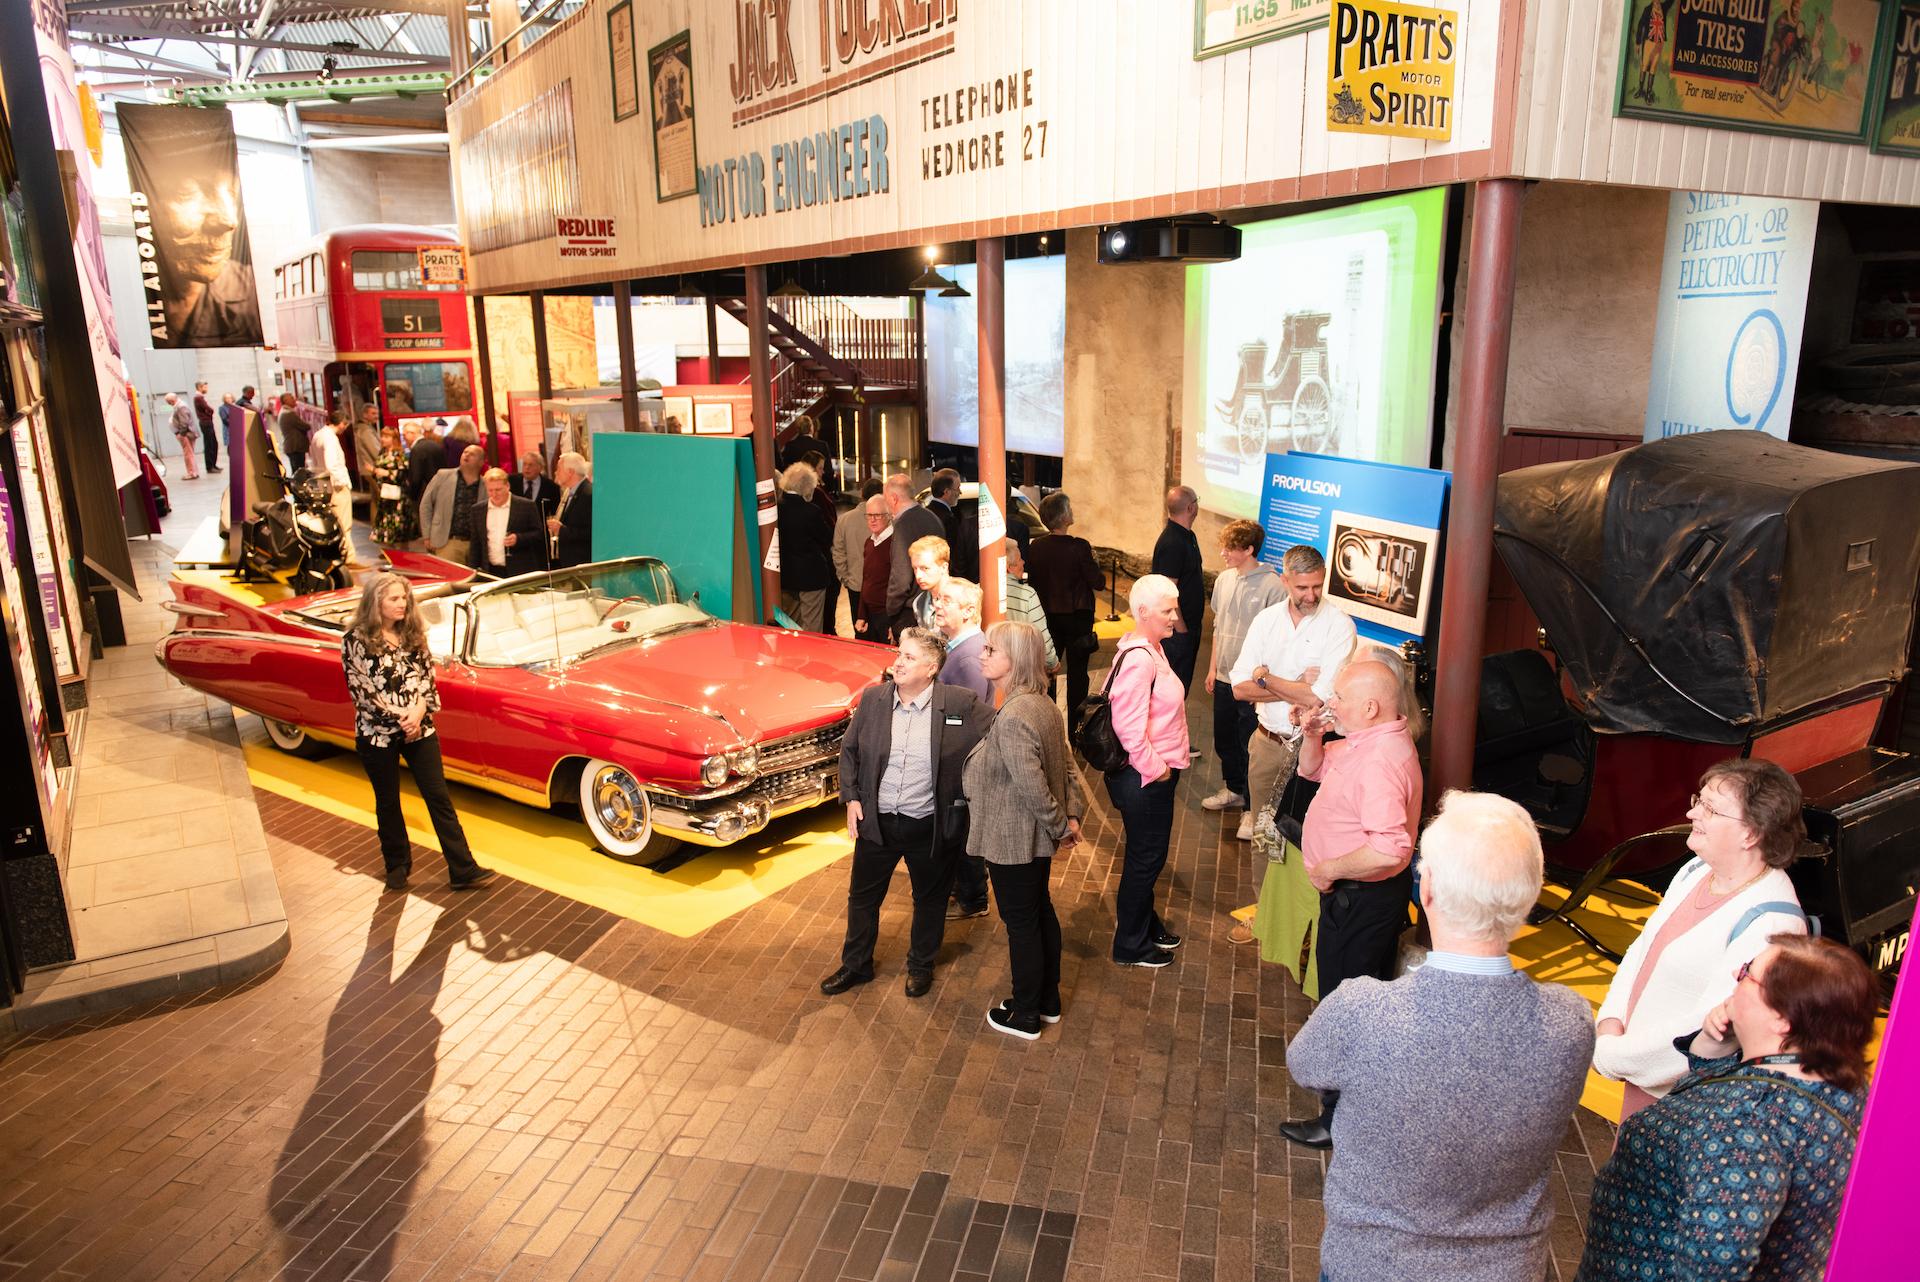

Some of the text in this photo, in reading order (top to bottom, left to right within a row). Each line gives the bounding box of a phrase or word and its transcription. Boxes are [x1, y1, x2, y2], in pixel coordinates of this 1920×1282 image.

[730, 0, 797, 104] JACK
[1333, 2, 1453, 79] PRATT'S
[1696, 18, 1746, 54] TYRES
[1401, 71, 1441, 86] MOTOR
[1676, 48, 1759, 75] AND ACCESSORIES
[921, 68, 1034, 133] TELEPHONE
[1369, 82, 1450, 129] SPIRIT
[1701, 86, 1717, 100] real
[921, 120, 1048, 181] WEDMORE 27
[699, 151, 766, 229] MOTOR
[771, 113, 889, 215] ENGINEER
[557, 216, 616, 238] REDLINE
[1682, 207, 1789, 253] PETROL OR
[130, 191, 169, 340] ALL ABOARD
[425, 254, 461, 266] PRATTS
[560, 246, 617, 257] MOTOR SPIRIT
[1678, 250, 1786, 290] ELECTRICITY
[403, 314, 423, 332] 51
[390, 339, 413, 348] SIDCUP
[1272, 474, 1342, 499] PROPULSION
